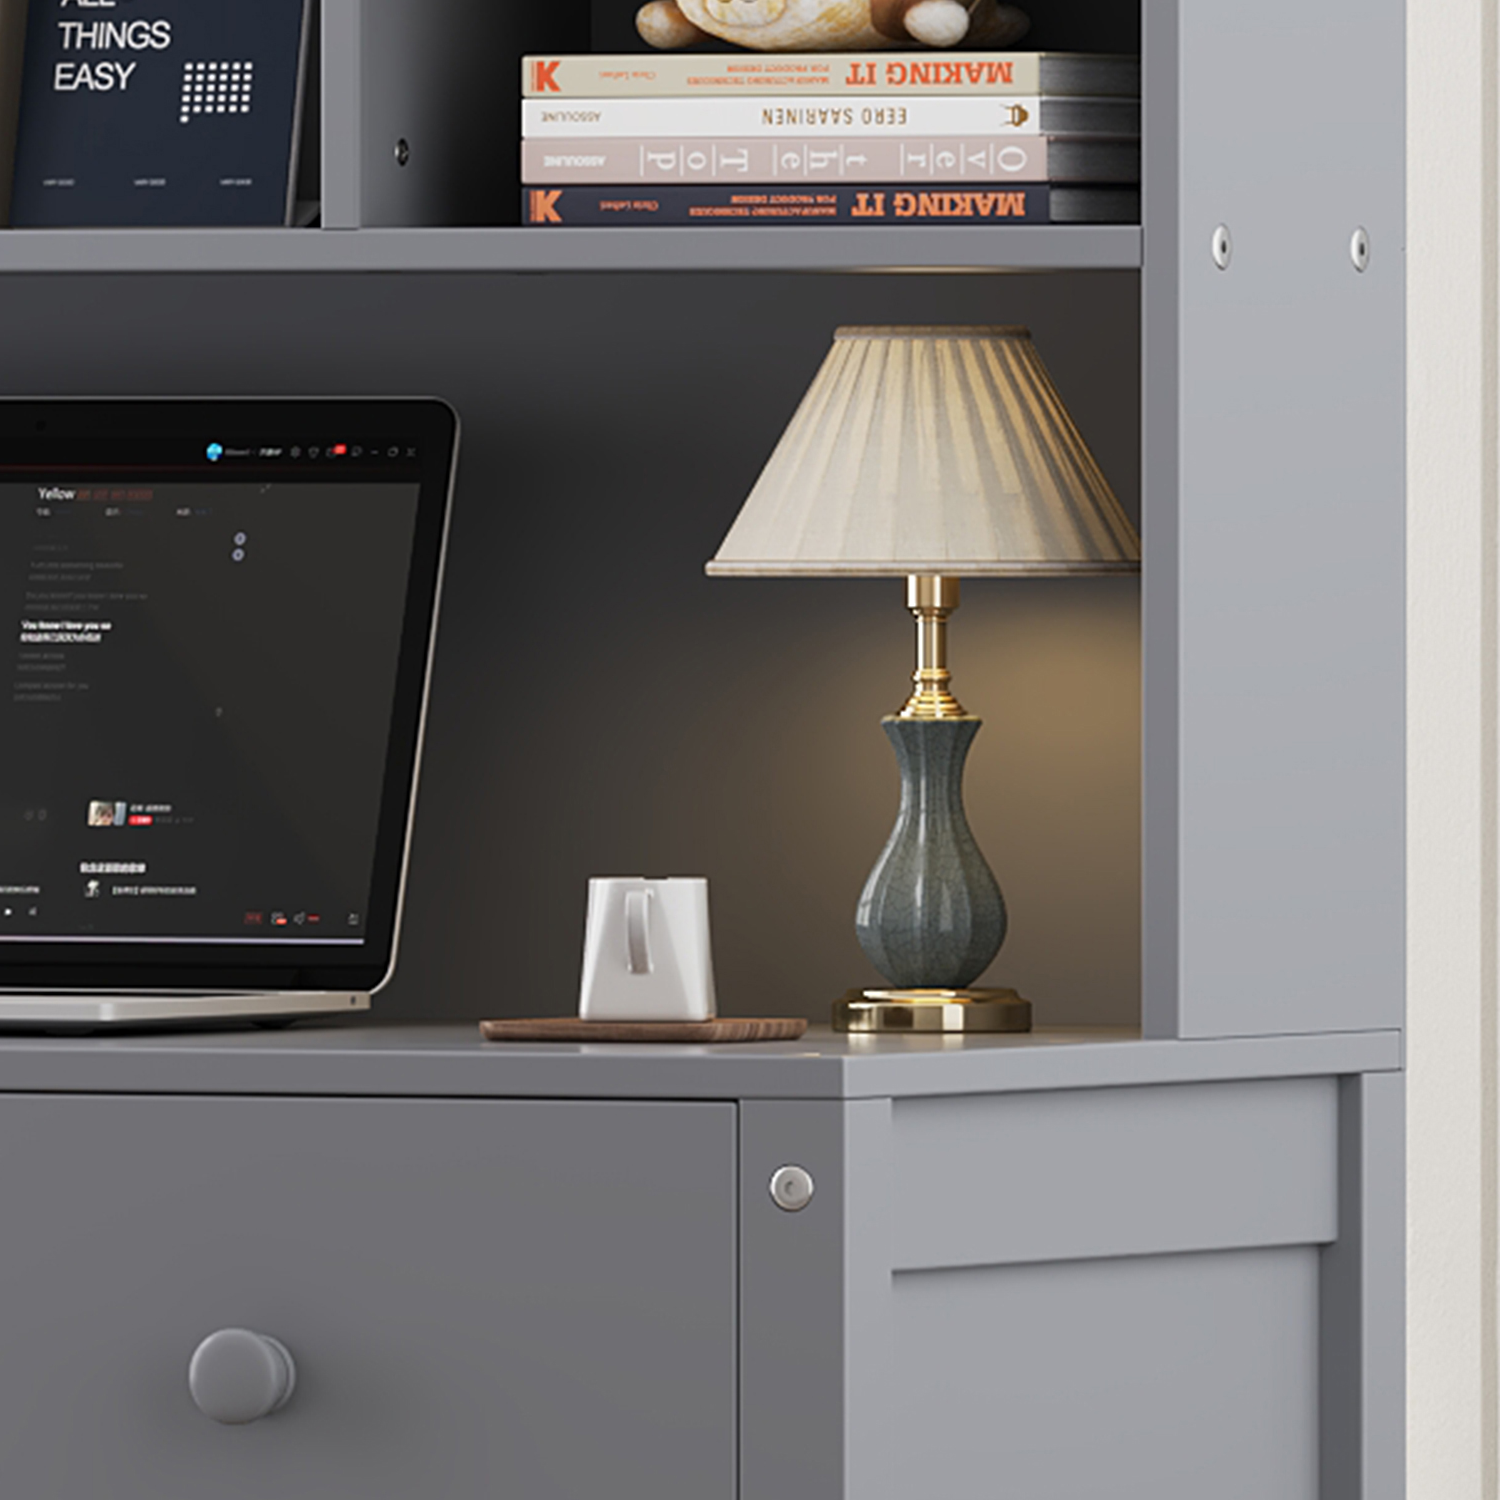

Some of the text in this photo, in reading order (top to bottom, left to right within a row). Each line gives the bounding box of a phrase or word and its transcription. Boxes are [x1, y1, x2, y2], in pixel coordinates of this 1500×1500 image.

[58, 20, 171, 50] THINGS
[54, 61, 137, 91] EASY
[845, 61, 1014, 86] MAKING IT
[762, 107, 907, 126] EERO SAARINEN
[850, 192, 1027, 217] MAKING IT
[37, 486, 77, 501] Yellow
